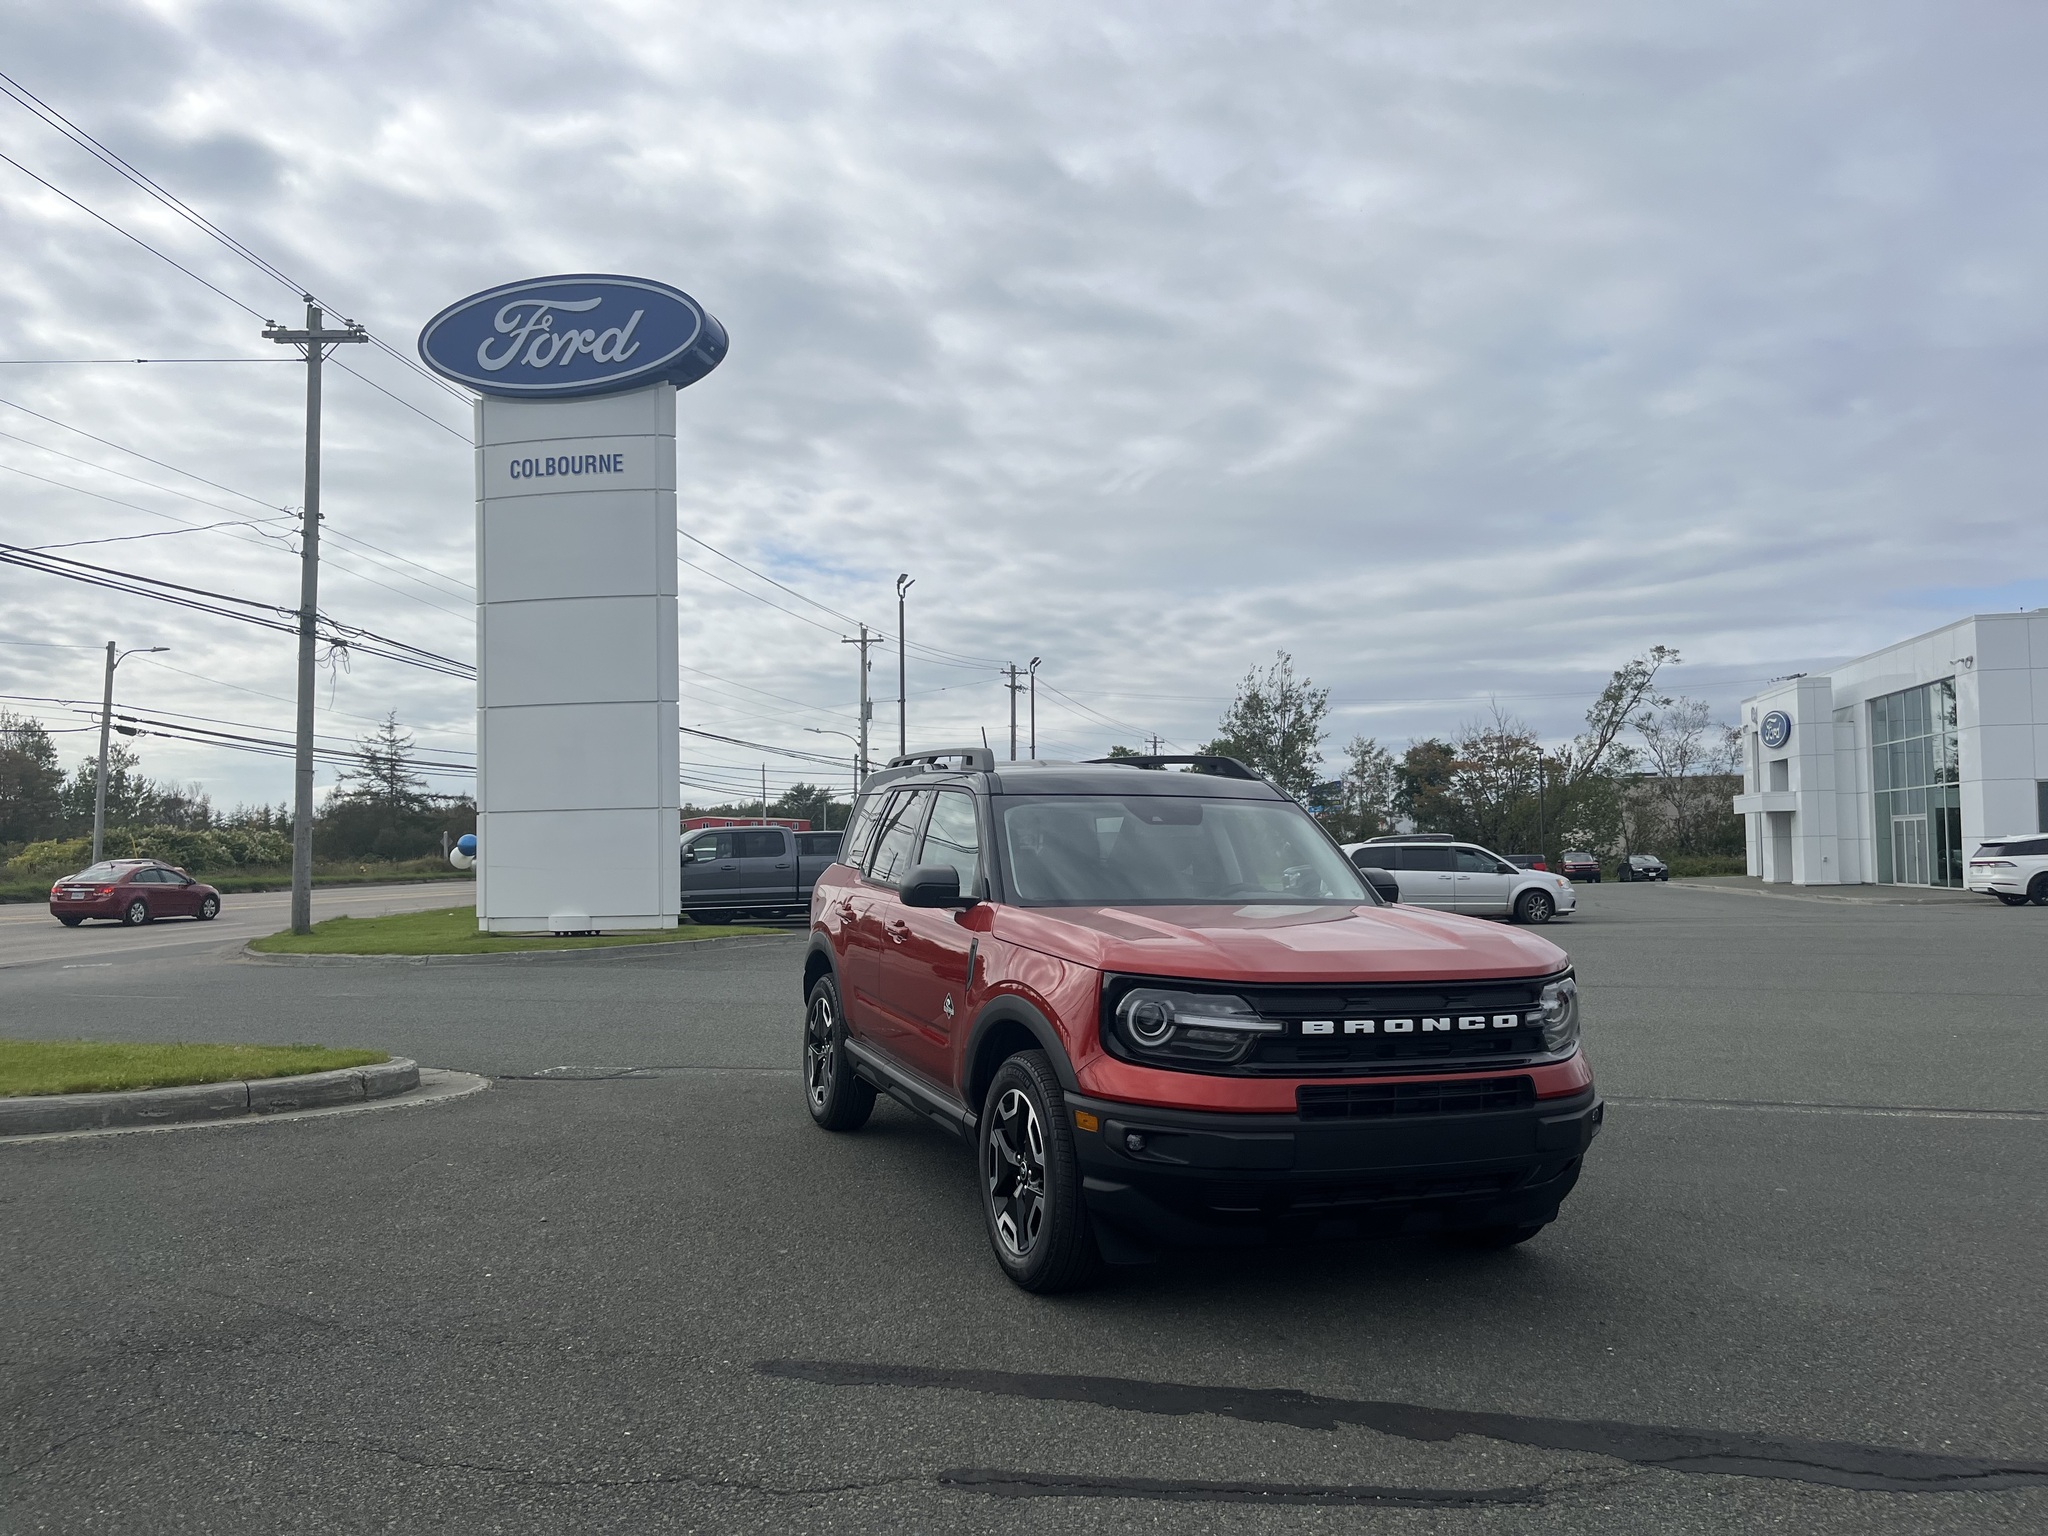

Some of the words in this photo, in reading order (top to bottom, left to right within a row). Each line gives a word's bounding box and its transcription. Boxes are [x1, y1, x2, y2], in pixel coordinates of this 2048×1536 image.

[477, 297, 645, 371] Ford
[510, 453, 624, 479] COLBOURNE
[1765, 718, 1781, 741] Ford
[1302, 1014, 1518, 1035] BRONCO
